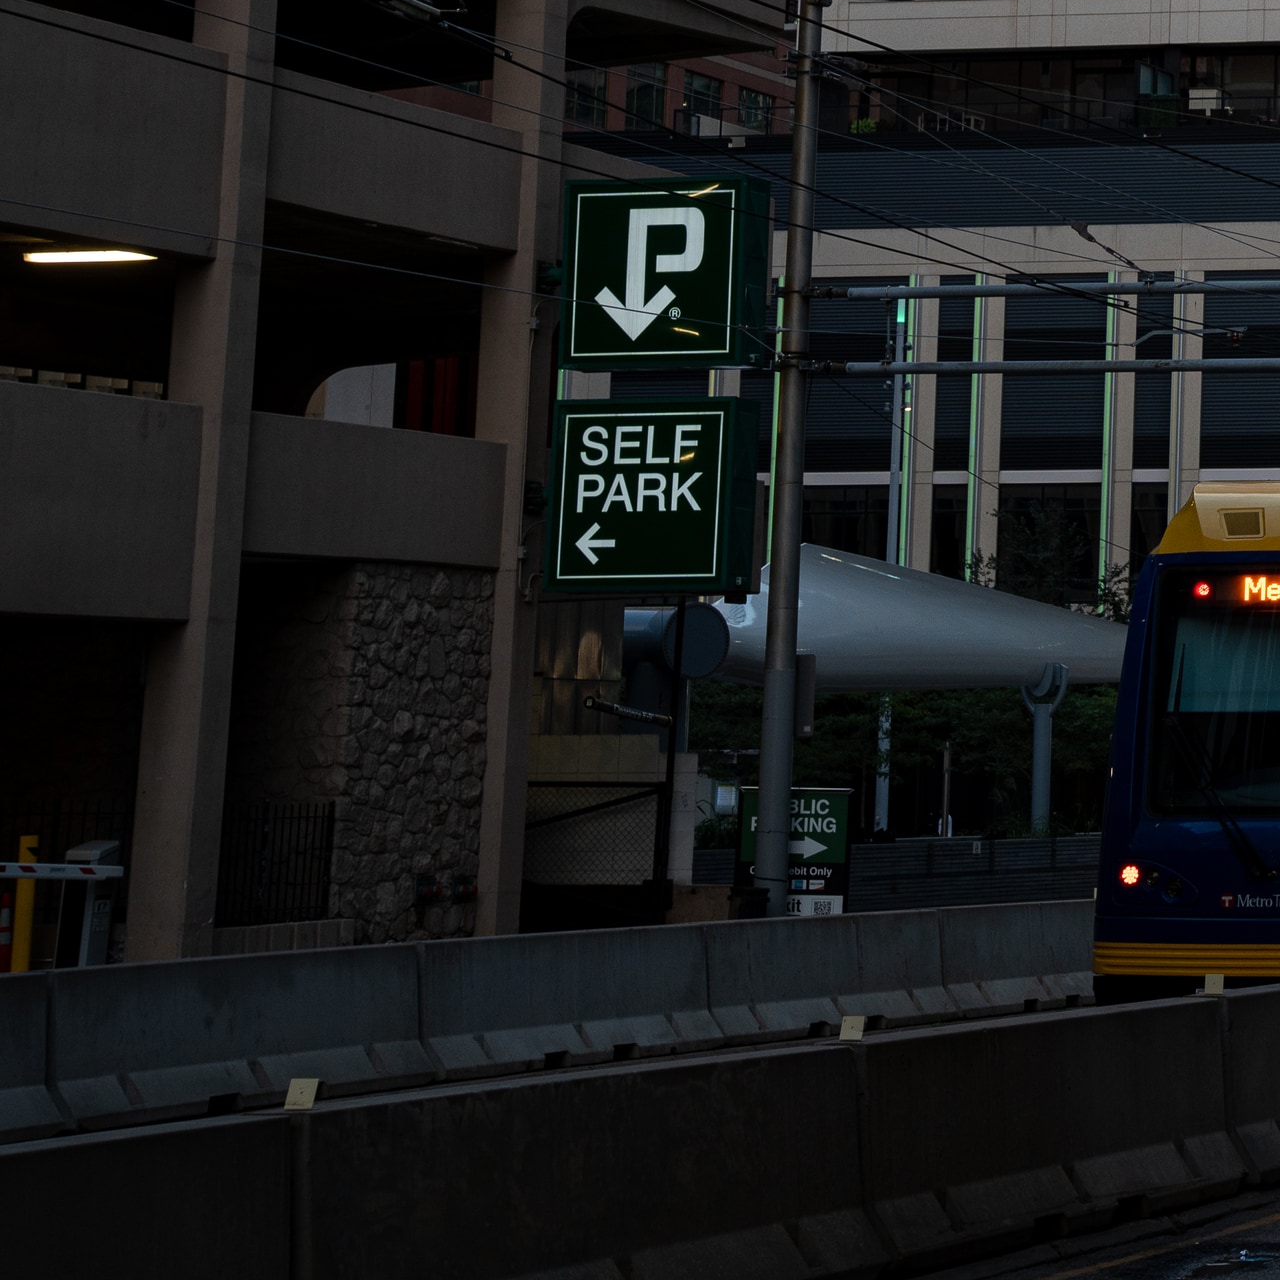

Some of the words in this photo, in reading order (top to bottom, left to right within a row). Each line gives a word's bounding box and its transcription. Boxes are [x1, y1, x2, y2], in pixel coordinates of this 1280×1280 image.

[579, 425, 703, 467] SELF
[575, 471, 705, 514] PARK
[809, 866, 833, 879] Only
